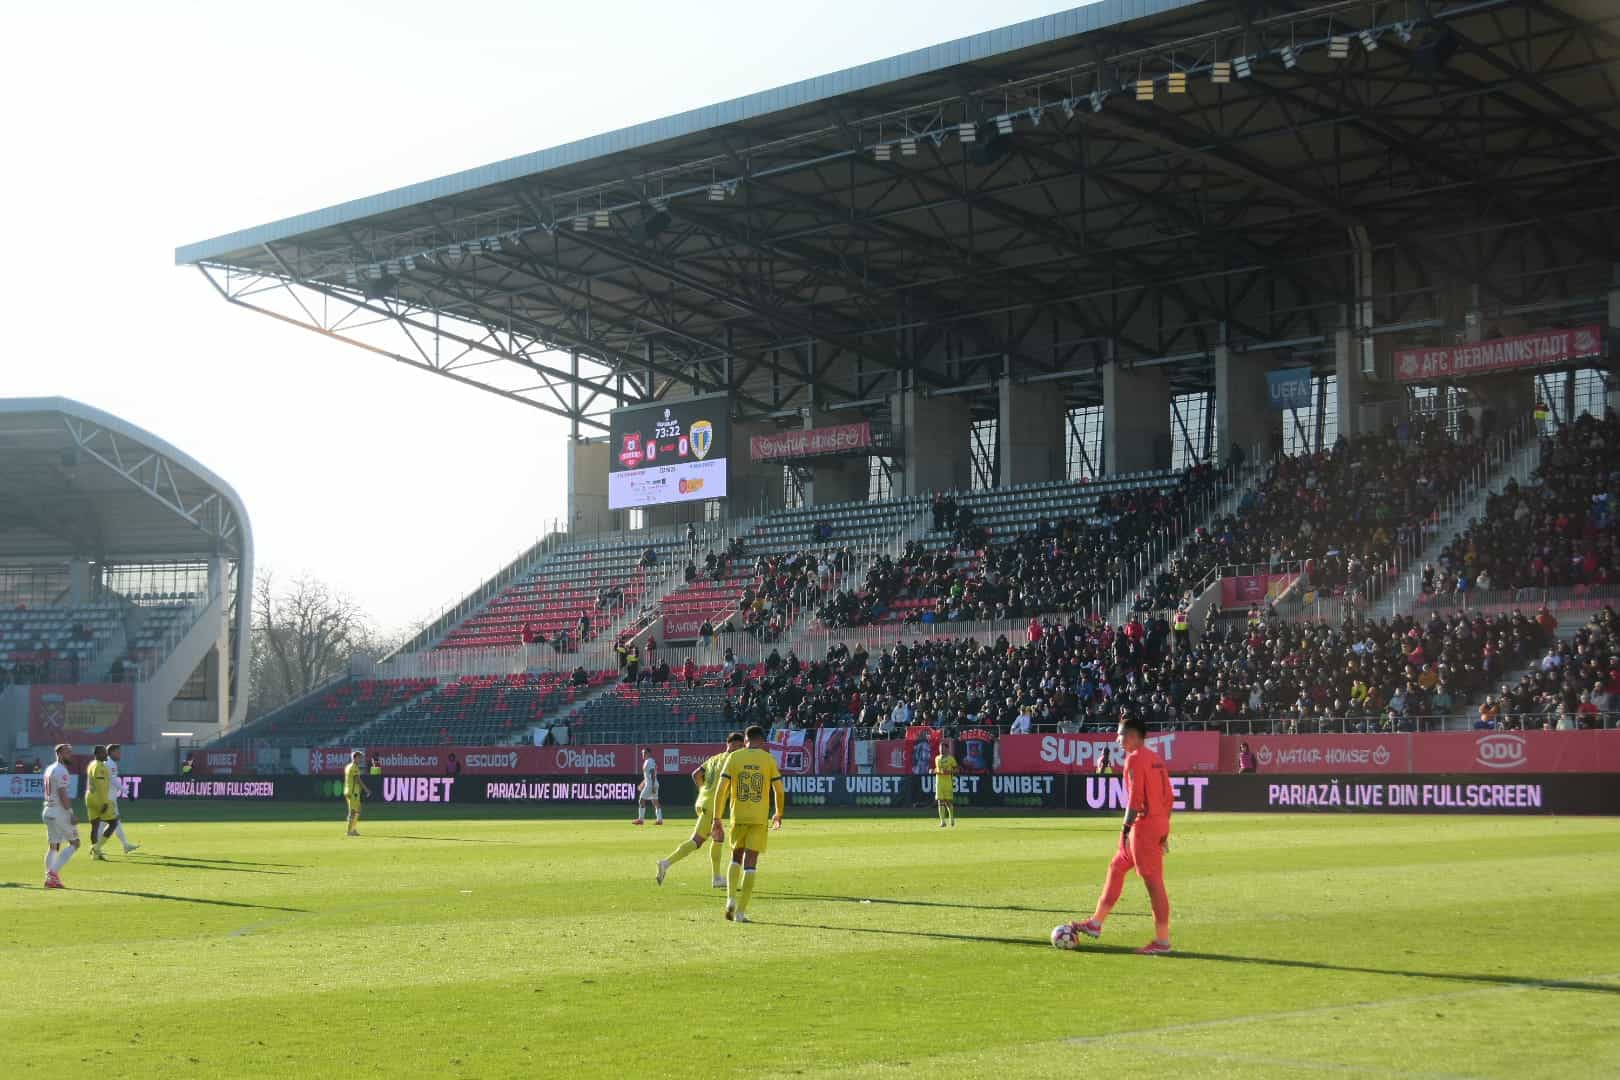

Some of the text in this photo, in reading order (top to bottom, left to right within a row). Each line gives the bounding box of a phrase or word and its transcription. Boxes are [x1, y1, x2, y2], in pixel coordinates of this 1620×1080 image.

[1423, 335, 1568, 372] AFC HERMANNSTADT
[1271, 381, 1308, 399] UEFA
[655, 426, 681, 439] 73:22
[647, 443, 656, 460] 0
[679, 438, 688, 456] 0
[1040, 735, 1176, 767] SUPERET
[1325, 748, 1370, 763] HOUSE
[1479, 743, 1522, 759] ODU
[568, 751, 616, 773] Palplast
[196, 782, 212, 795] LIVE
[213, 782, 226, 795] DIN
[227, 782, 274, 796] FULLSCREEN
[383, 777, 454, 802] UNIBET
[530, 783, 550, 799] LIVE
[552, 783, 569, 799] DIN
[571, 783, 636, 800] FULLSCREEN
[782, 776, 836, 793] UNIBET
[846, 776, 902, 793] UNIBET
[921, 776, 979, 793] UBET
[992, 776, 1054, 793] UNIBET
[1086, 777, 1209, 809] UNET
[1269, 778, 1542, 807] PARIAZĂ LIVE DIN FULLSCREEN
